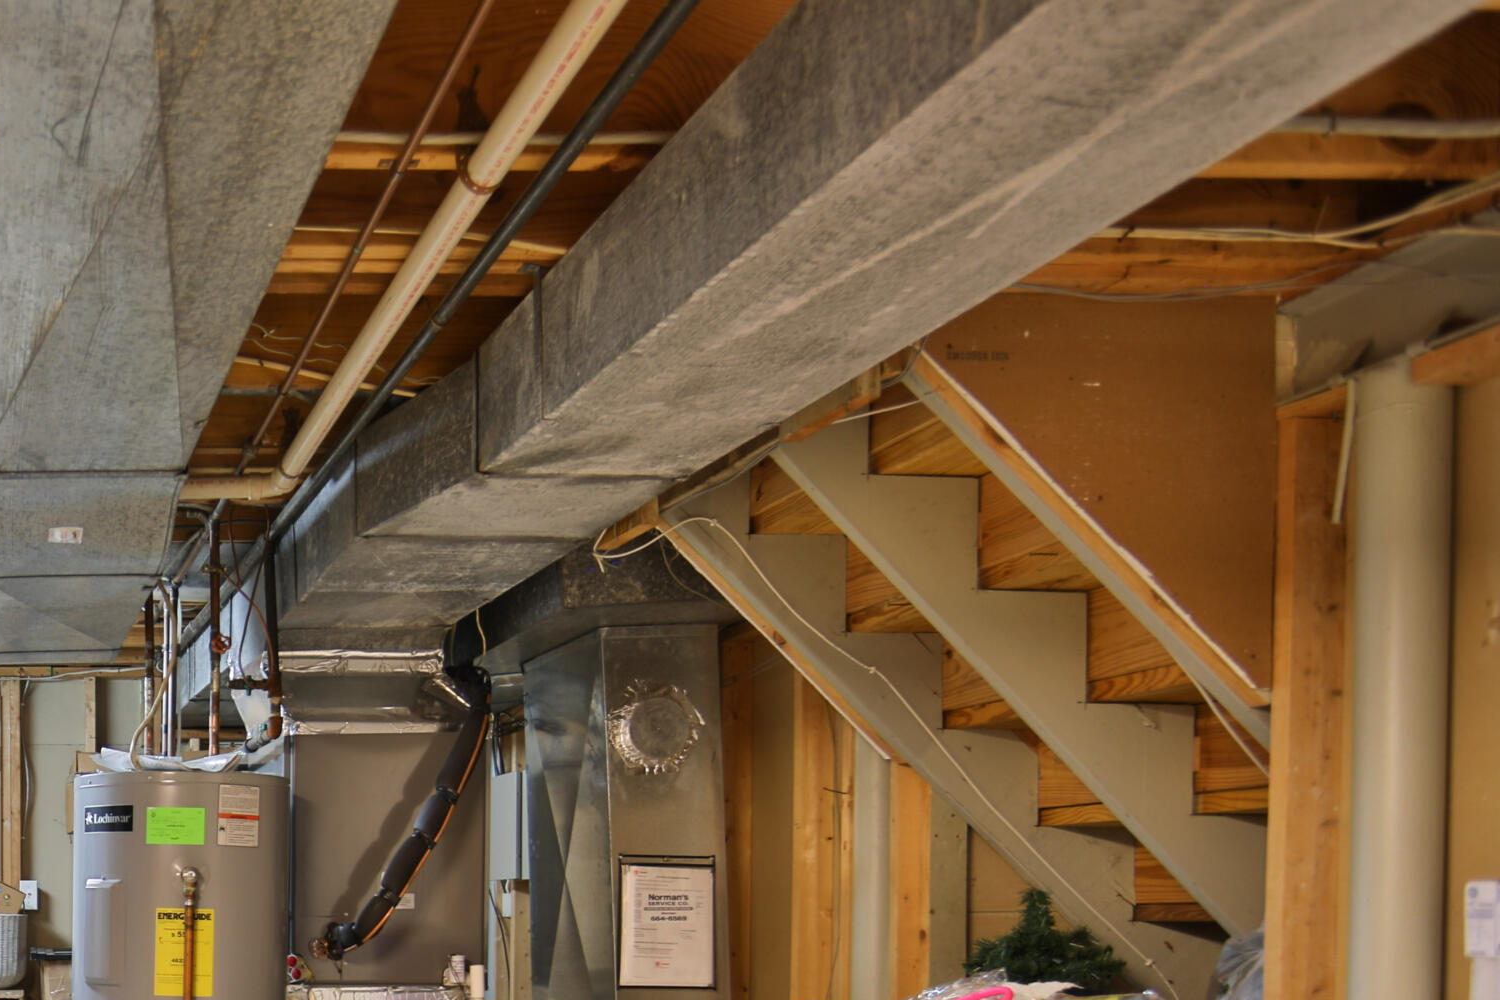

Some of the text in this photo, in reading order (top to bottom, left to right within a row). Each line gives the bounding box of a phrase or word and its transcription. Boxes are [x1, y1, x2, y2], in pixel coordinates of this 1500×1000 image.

[93, 813, 131, 824] Lochinvar
[648, 893, 689, 901] Norman's
[157, 912, 213, 921] ENERGUIDE
